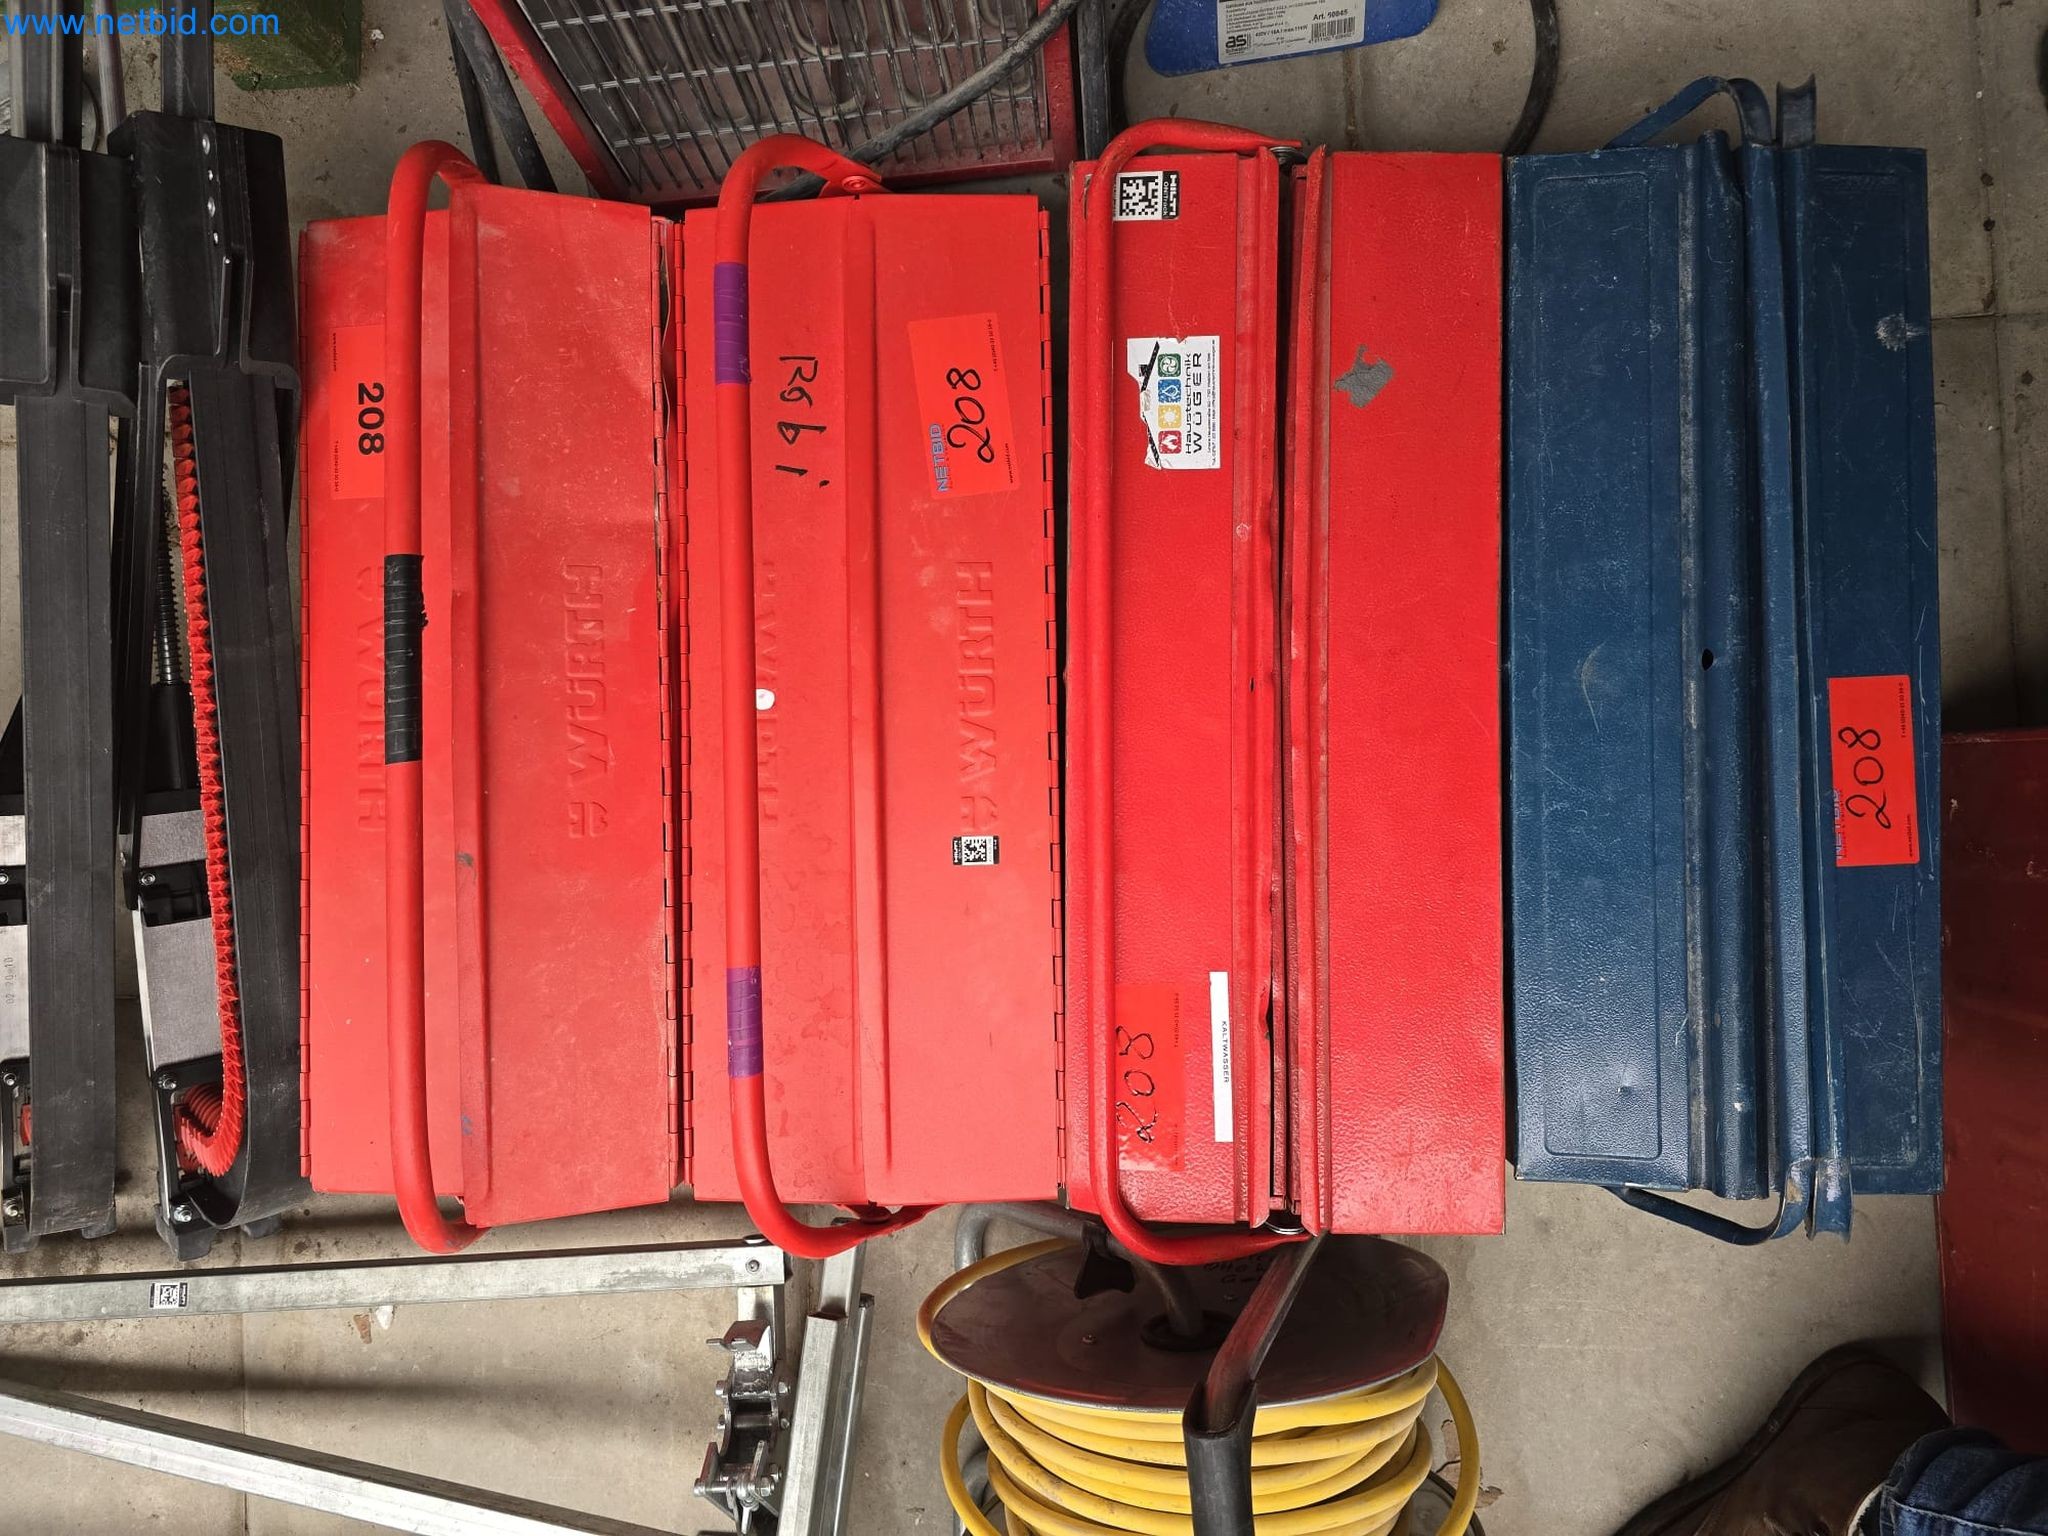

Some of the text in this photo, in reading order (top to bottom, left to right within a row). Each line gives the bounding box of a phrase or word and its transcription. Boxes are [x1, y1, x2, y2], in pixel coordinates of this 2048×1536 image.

[1169, 174, 1177, 216] HILTI
[358, 382, 385, 456] 208
[929, 423, 949, 492] NETBID
[946, 367, 995, 463] 208
[563, 563, 609, 787] WÜRTH
[954, 561, 997, 783] WÜRTH
[1838, 726, 1892, 830] 208
[1115, 1025, 1158, 1143] 208
[1221, 1020, 1230, 1083] KALTWASSER
